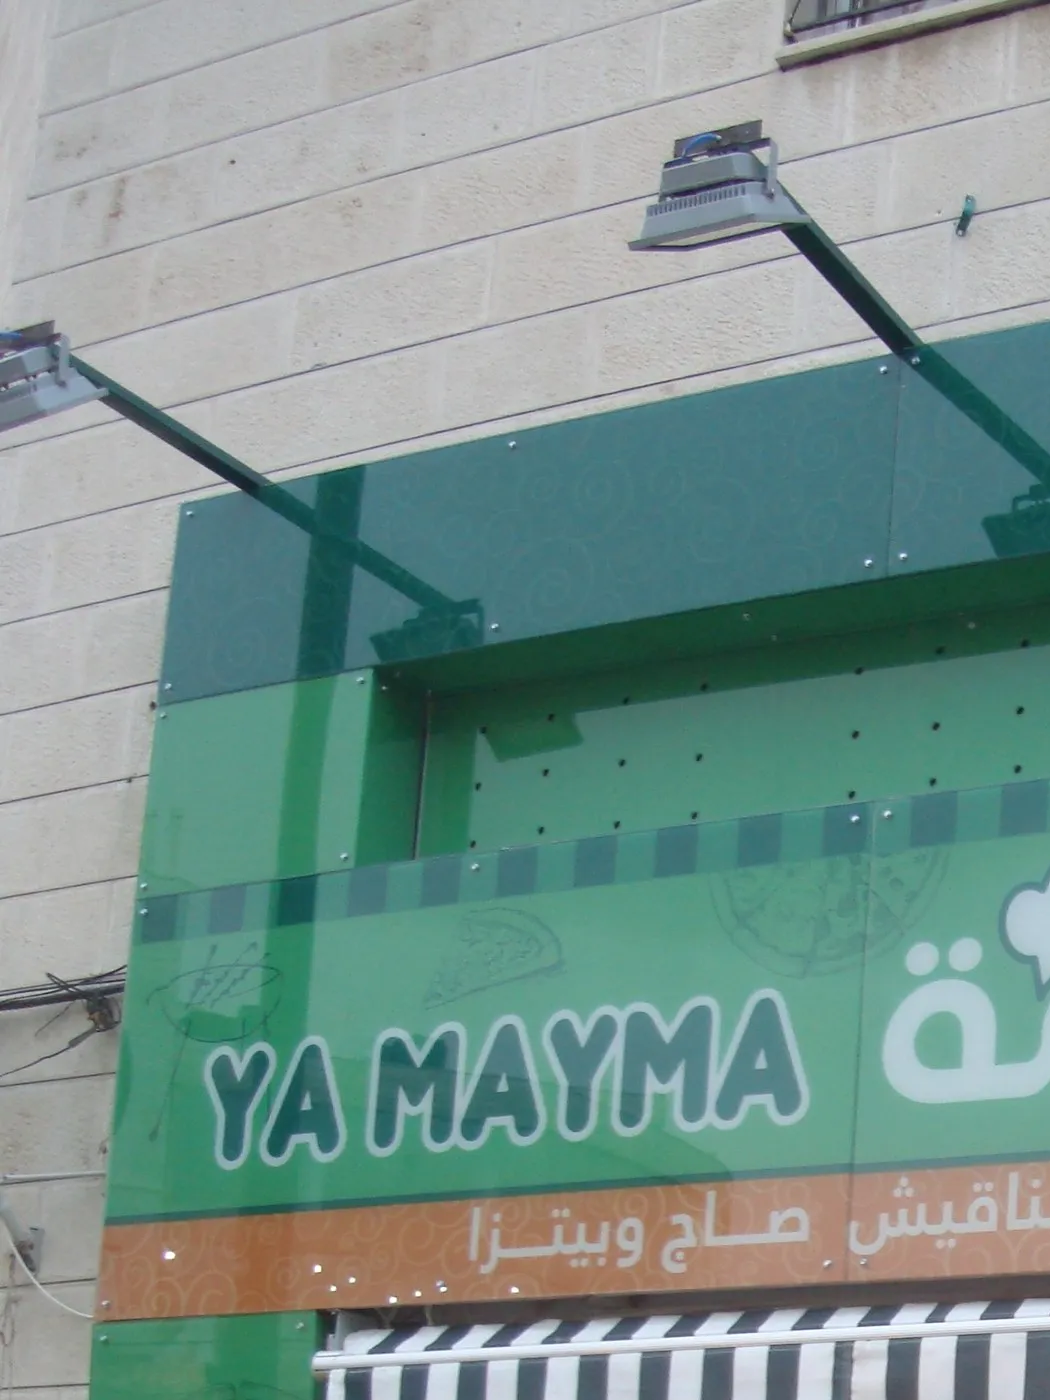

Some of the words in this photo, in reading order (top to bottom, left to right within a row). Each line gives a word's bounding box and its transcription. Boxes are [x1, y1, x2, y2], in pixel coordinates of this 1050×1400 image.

[204, 1034, 348, 1171] YA
[365, 988, 810, 1159] MAYMA
[660, 1190, 810, 1274] صاج
